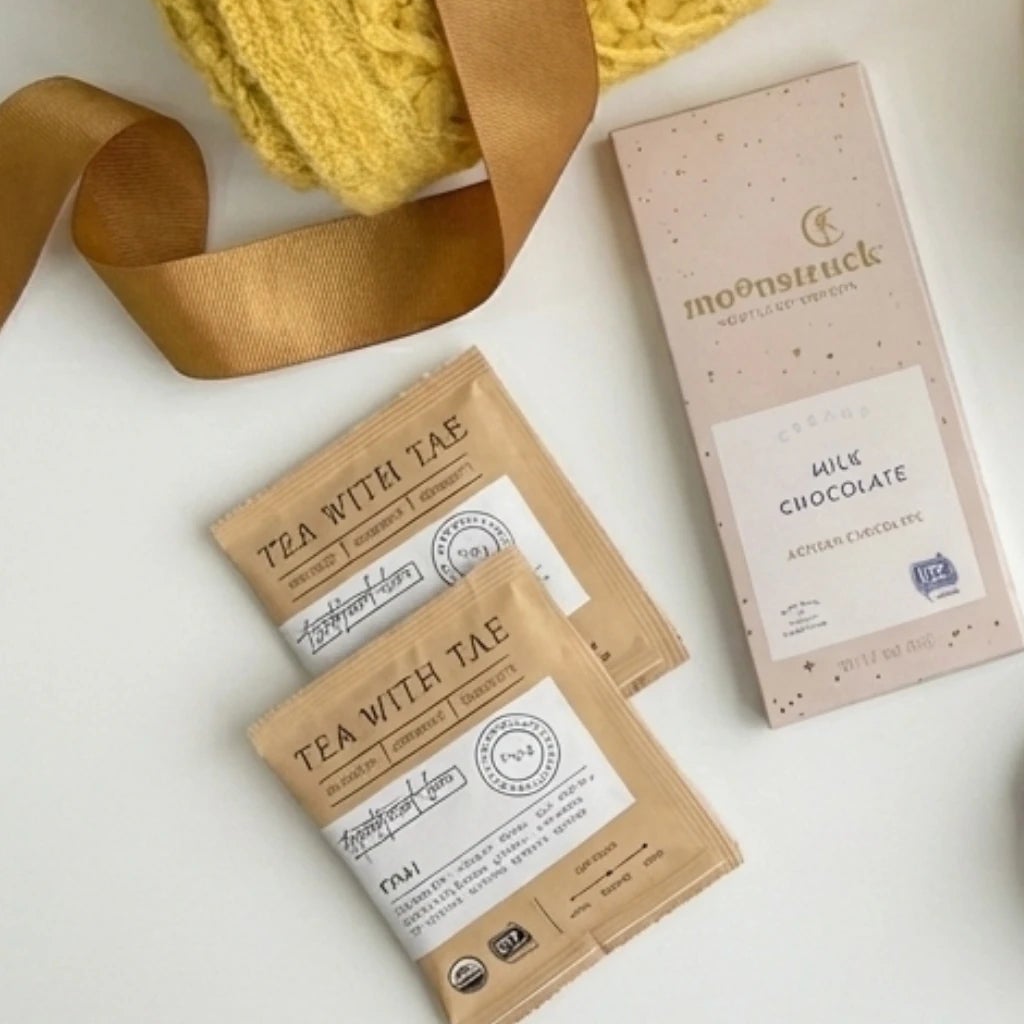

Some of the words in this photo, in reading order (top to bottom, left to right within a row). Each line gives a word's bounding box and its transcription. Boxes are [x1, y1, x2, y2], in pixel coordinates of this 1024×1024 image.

[683, 240, 882, 320] moonstruck
[293, 723, 358, 772] TEA
[359, 661, 442, 727] WITH
[445, 616, 510, 668] TAE
